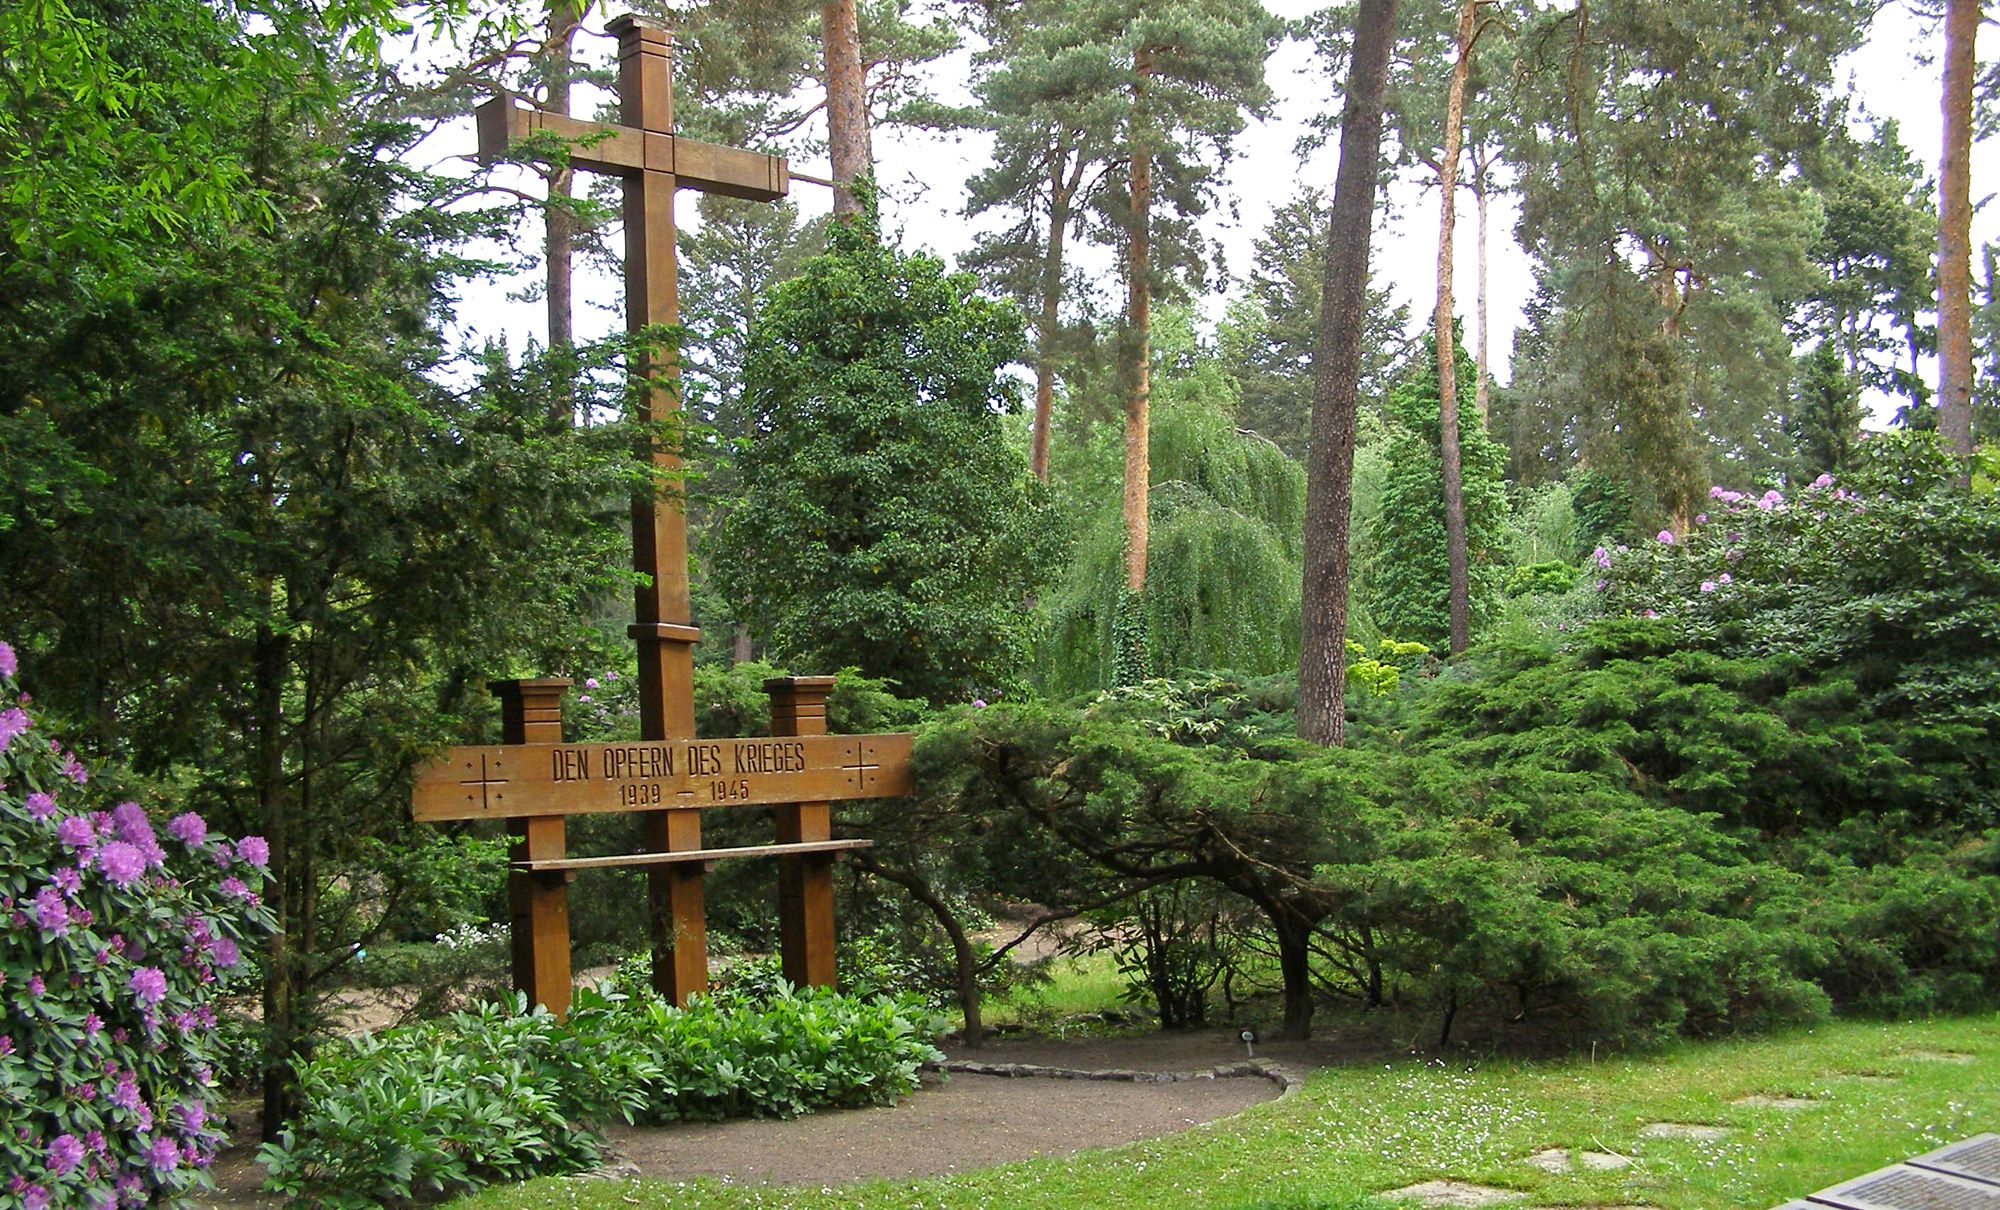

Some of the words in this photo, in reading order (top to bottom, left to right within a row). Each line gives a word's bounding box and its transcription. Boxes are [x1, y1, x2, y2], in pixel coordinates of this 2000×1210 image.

[552, 749, 589, 781] DEN
[603, 747, 673, 779] OPFERN
[688, 745, 721, 776] DES
[735, 742, 805, 773] KRIEGES
[619, 784, 660, 806] 1939
[709, 780, 749, 801] 1945
